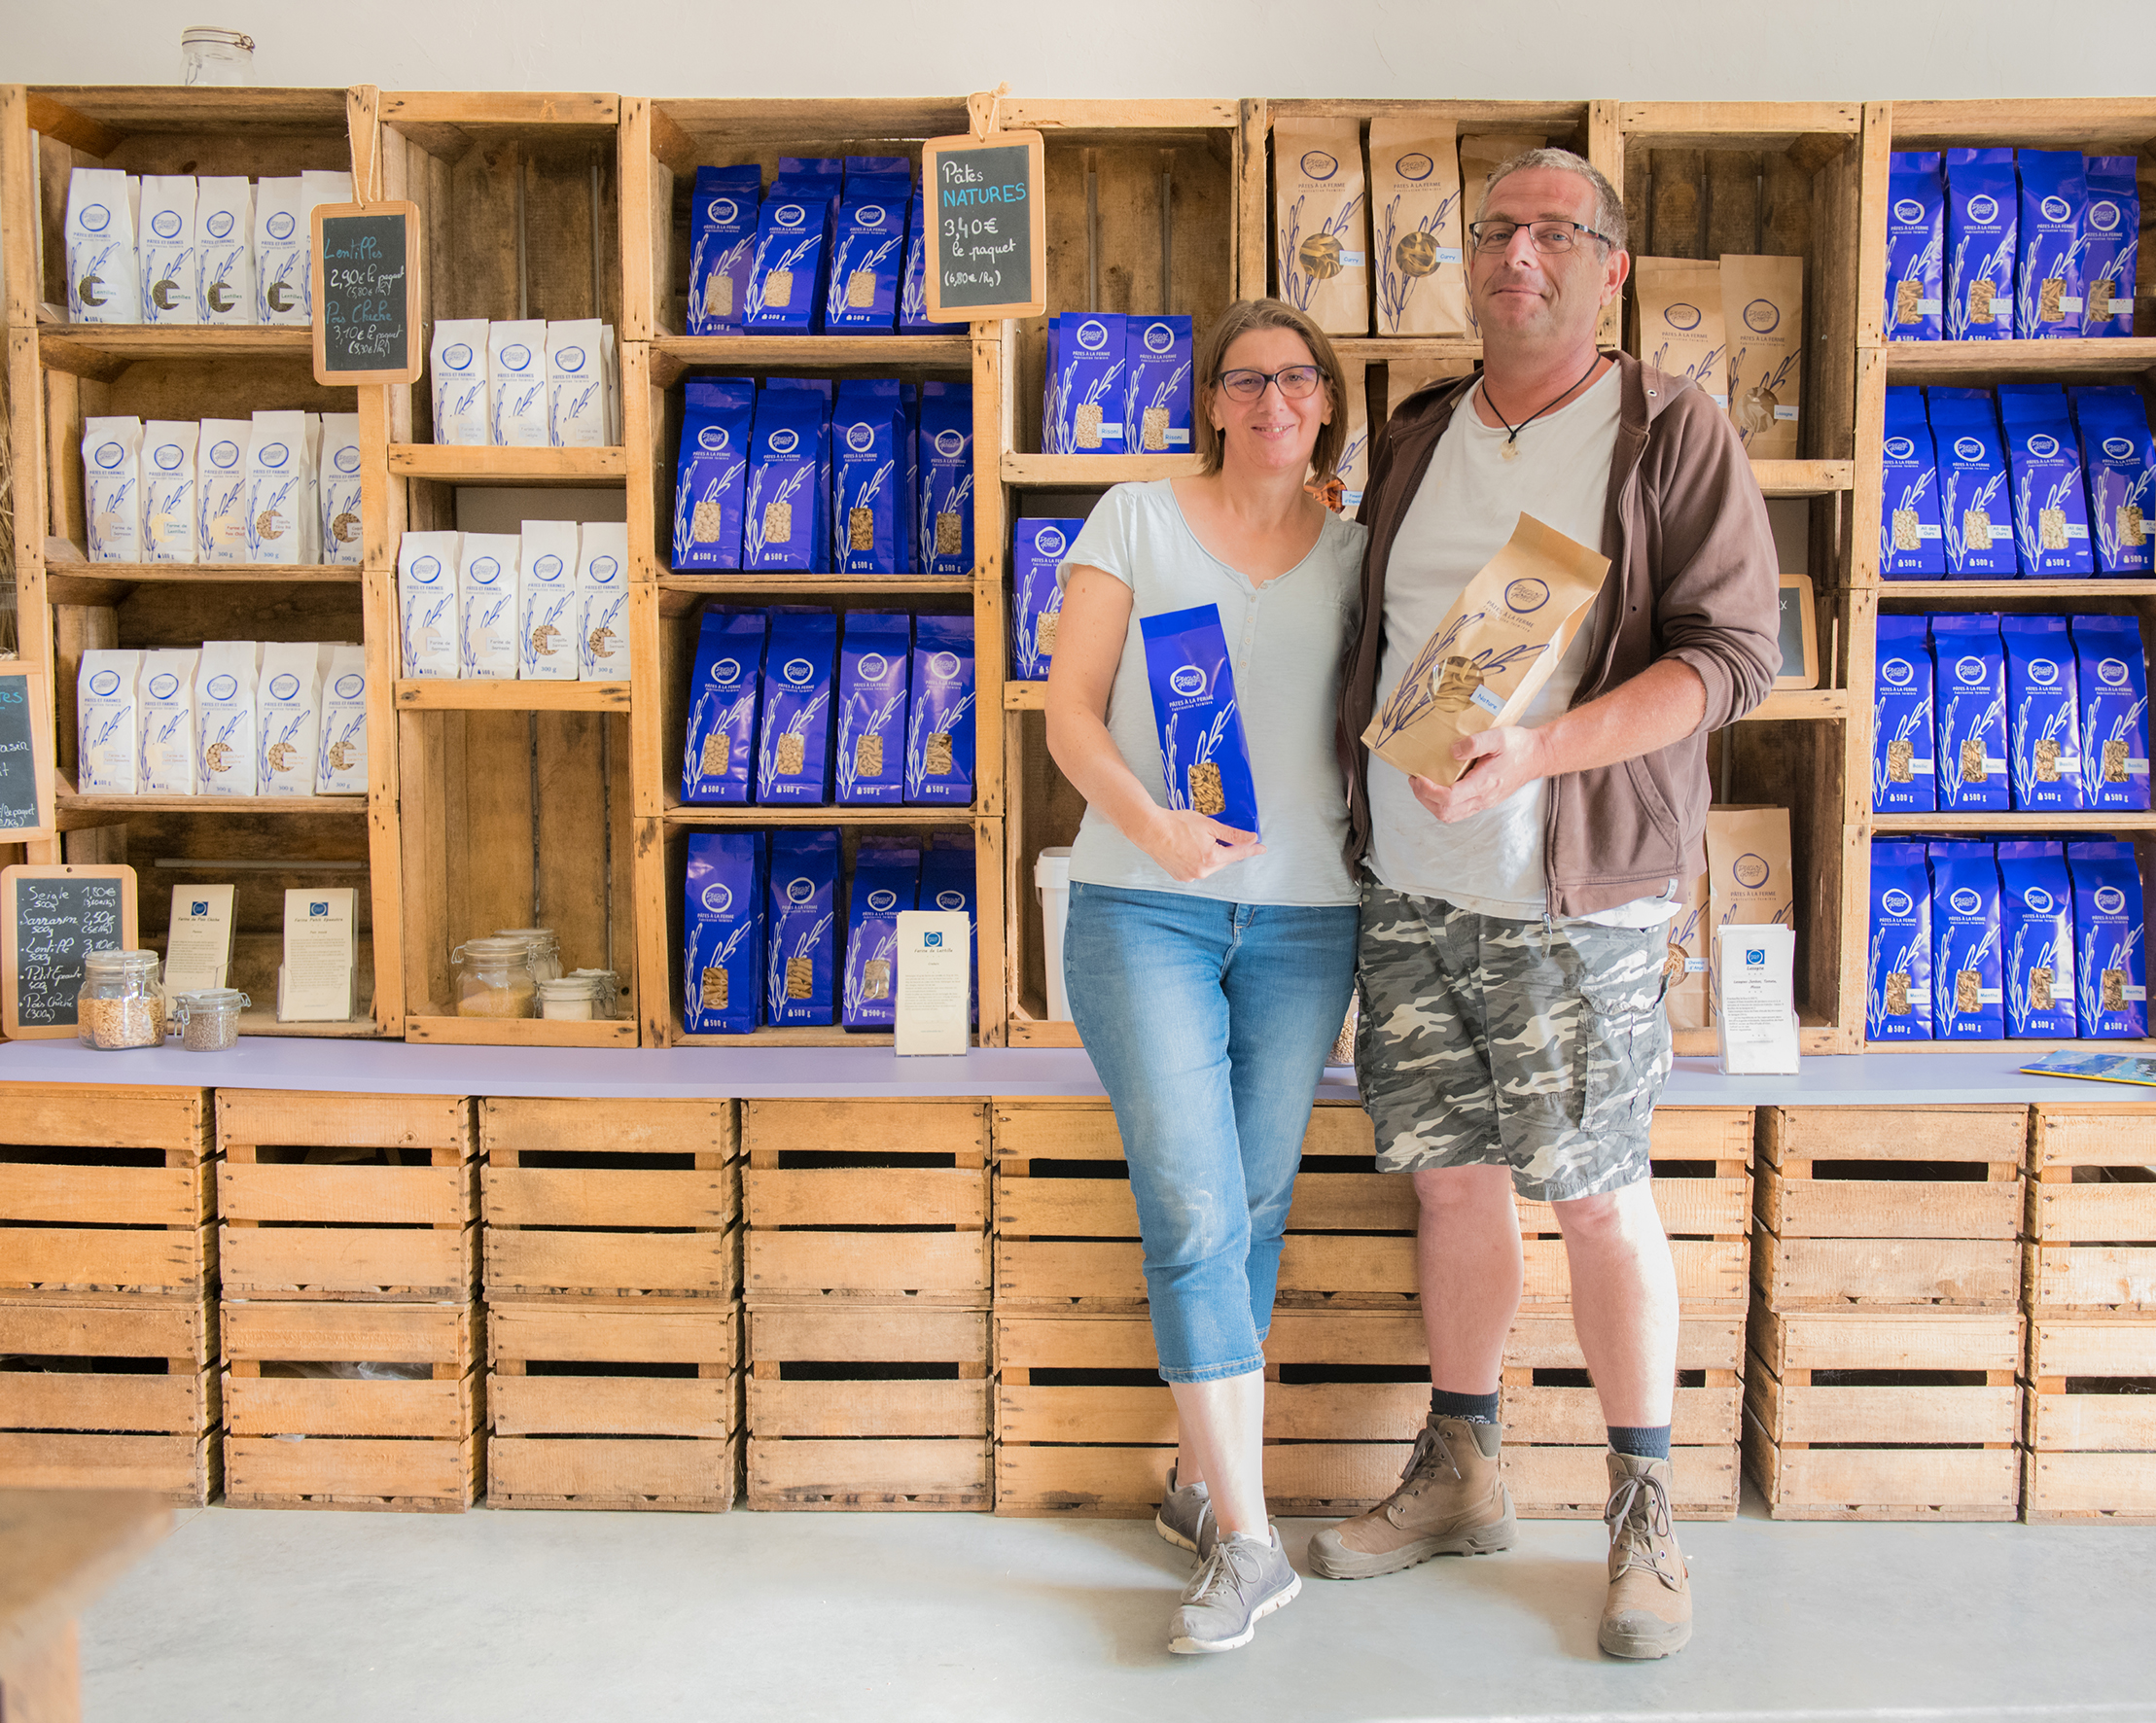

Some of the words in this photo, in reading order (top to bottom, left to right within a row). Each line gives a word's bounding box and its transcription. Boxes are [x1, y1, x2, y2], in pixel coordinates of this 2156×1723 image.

[942, 160, 983, 184] Pâtes
[943, 182, 1026, 207] NATURES
[944, 217, 999, 239] 3,40€
[324, 236, 382, 260] Lentilles
[952, 240, 965, 257] le
[969, 238, 1016, 264] paquet
[331, 269, 366, 290] 2,90€
[377, 265, 405, 289] paquet
[327, 300, 346, 324] Pois
[352, 299, 392, 323] Chiche
[1486, 600, 1502, 615] PÂTES
[1515, 616, 1535, 628] FERME
[0, 691, 23, 704] res
[1169, 699, 1184, 708] PÂTES
[1476, 693, 1498, 710] Nature
[0, 741, 29, 753] asin
[28, 886, 70, 907] Seigle
[81, 886, 117, 899] 1,80€
[33, 900, 59, 912] 500g
[22, 908, 79, 925] Sarrasin
[83, 911, 116, 926] 2,50€
[31, 926, 54, 938] 500g
[26, 937, 74, 954] Lentille
[28, 953, 52, 966] 500g
[25, 966, 53, 980] Petit
[23, 993, 46, 1008] Pois
[47, 992, 74, 1008] Chiche
[25, 1008, 55, 1022] (300g)
